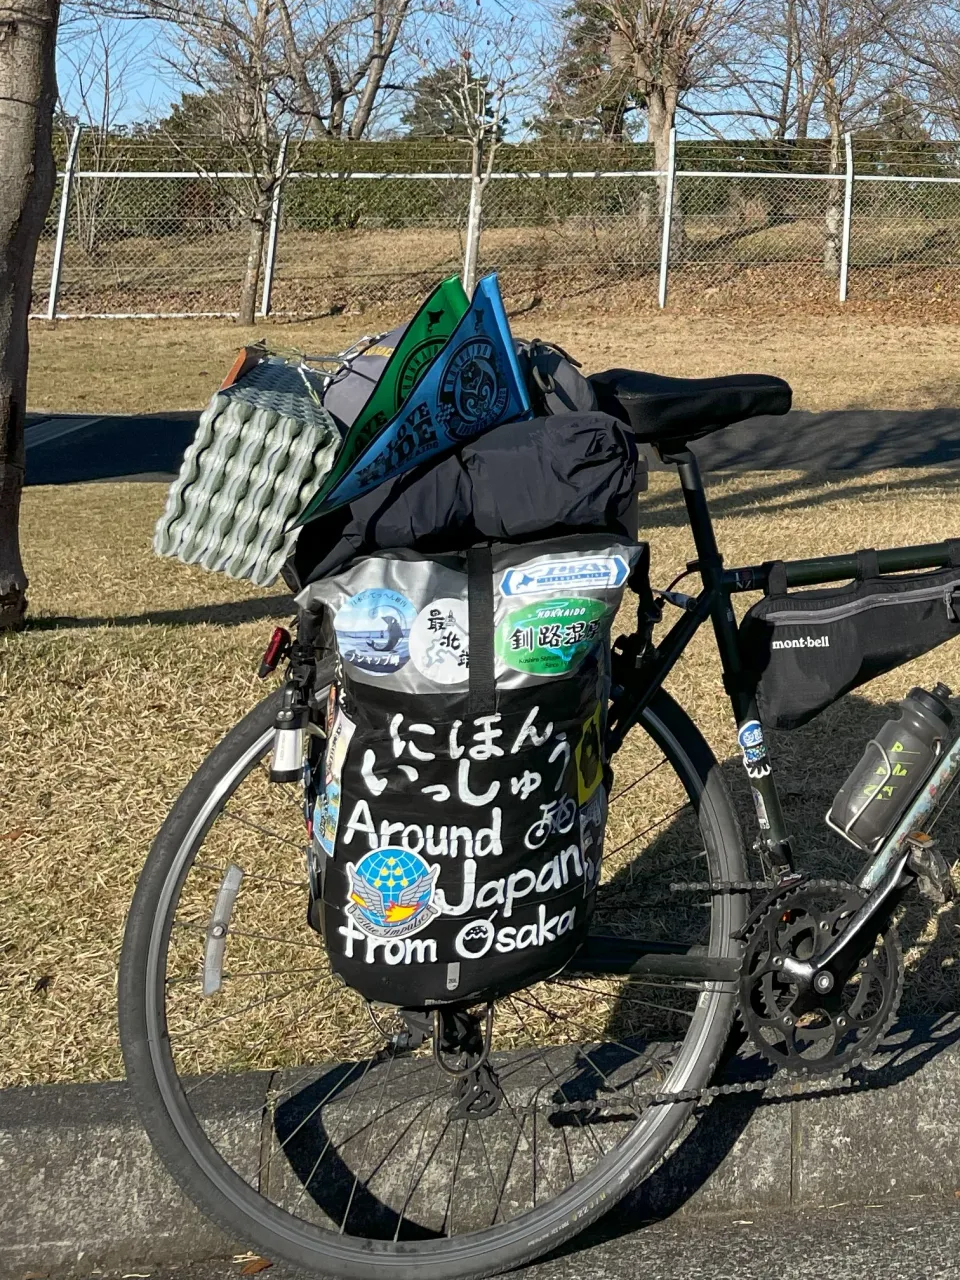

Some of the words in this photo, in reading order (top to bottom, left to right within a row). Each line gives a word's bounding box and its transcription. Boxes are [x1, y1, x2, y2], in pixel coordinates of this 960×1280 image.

[402, 344, 440, 390] HOKKAID
[537, 607, 586, 618] HOKKAIDO
[349, 653, 400, 667] ノシャップ岬
[389, 706, 553, 762] にほん
[361, 732, 571, 807] いっしゅう
[343, 799, 503, 858] Around
[432, 843, 584, 918] Japan
[338, 916, 438, 965] from
[455, 904, 577, 959] Osaka
[353, 912, 381, 935] Blue
[382, 912, 430, 936] Impulse
